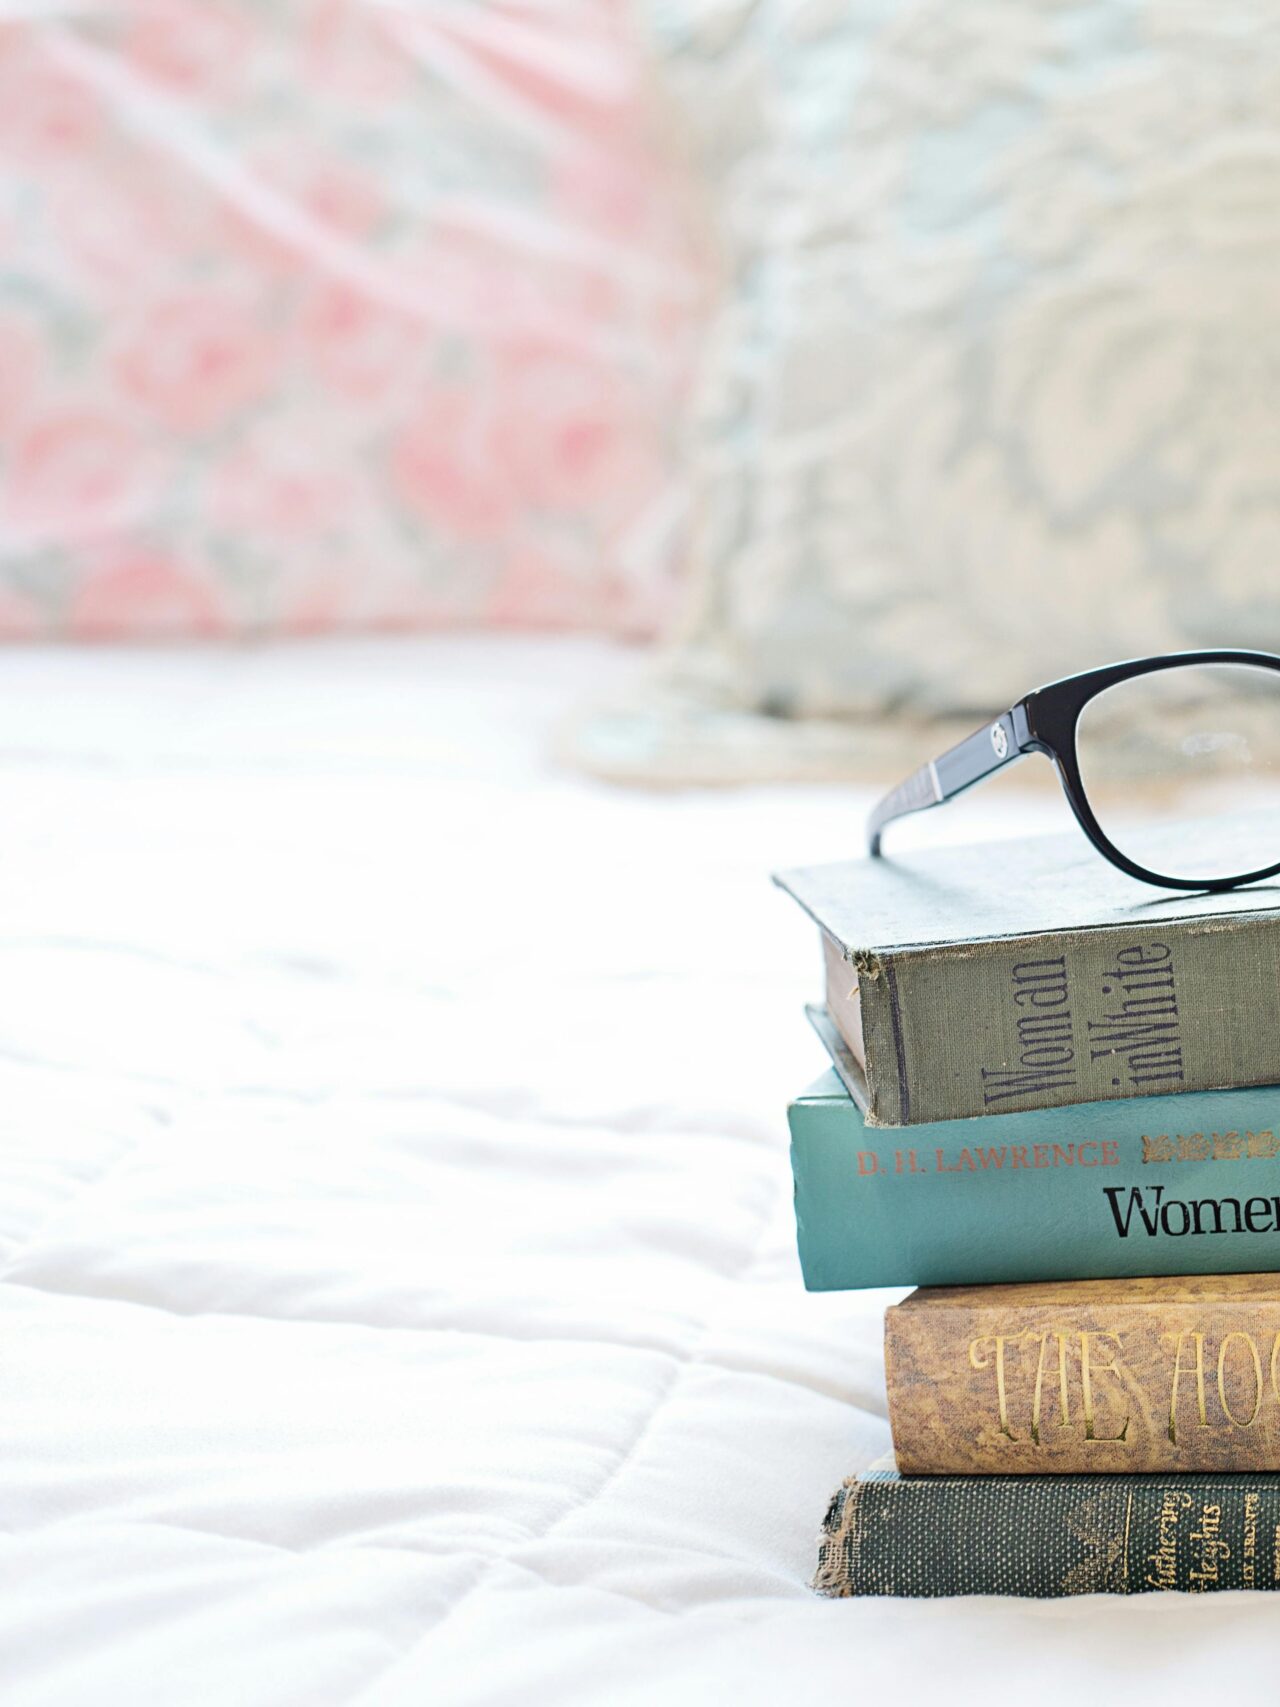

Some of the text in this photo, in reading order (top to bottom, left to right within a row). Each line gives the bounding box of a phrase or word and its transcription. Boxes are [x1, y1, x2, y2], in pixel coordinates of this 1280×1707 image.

[981, 953, 1078, 1105] Woman
[1089, 941, 1185, 1088] in White
[856, 1140, 1121, 1177] D. H. LAWRENCE
[968, 1325, 1132, 1448] THE
